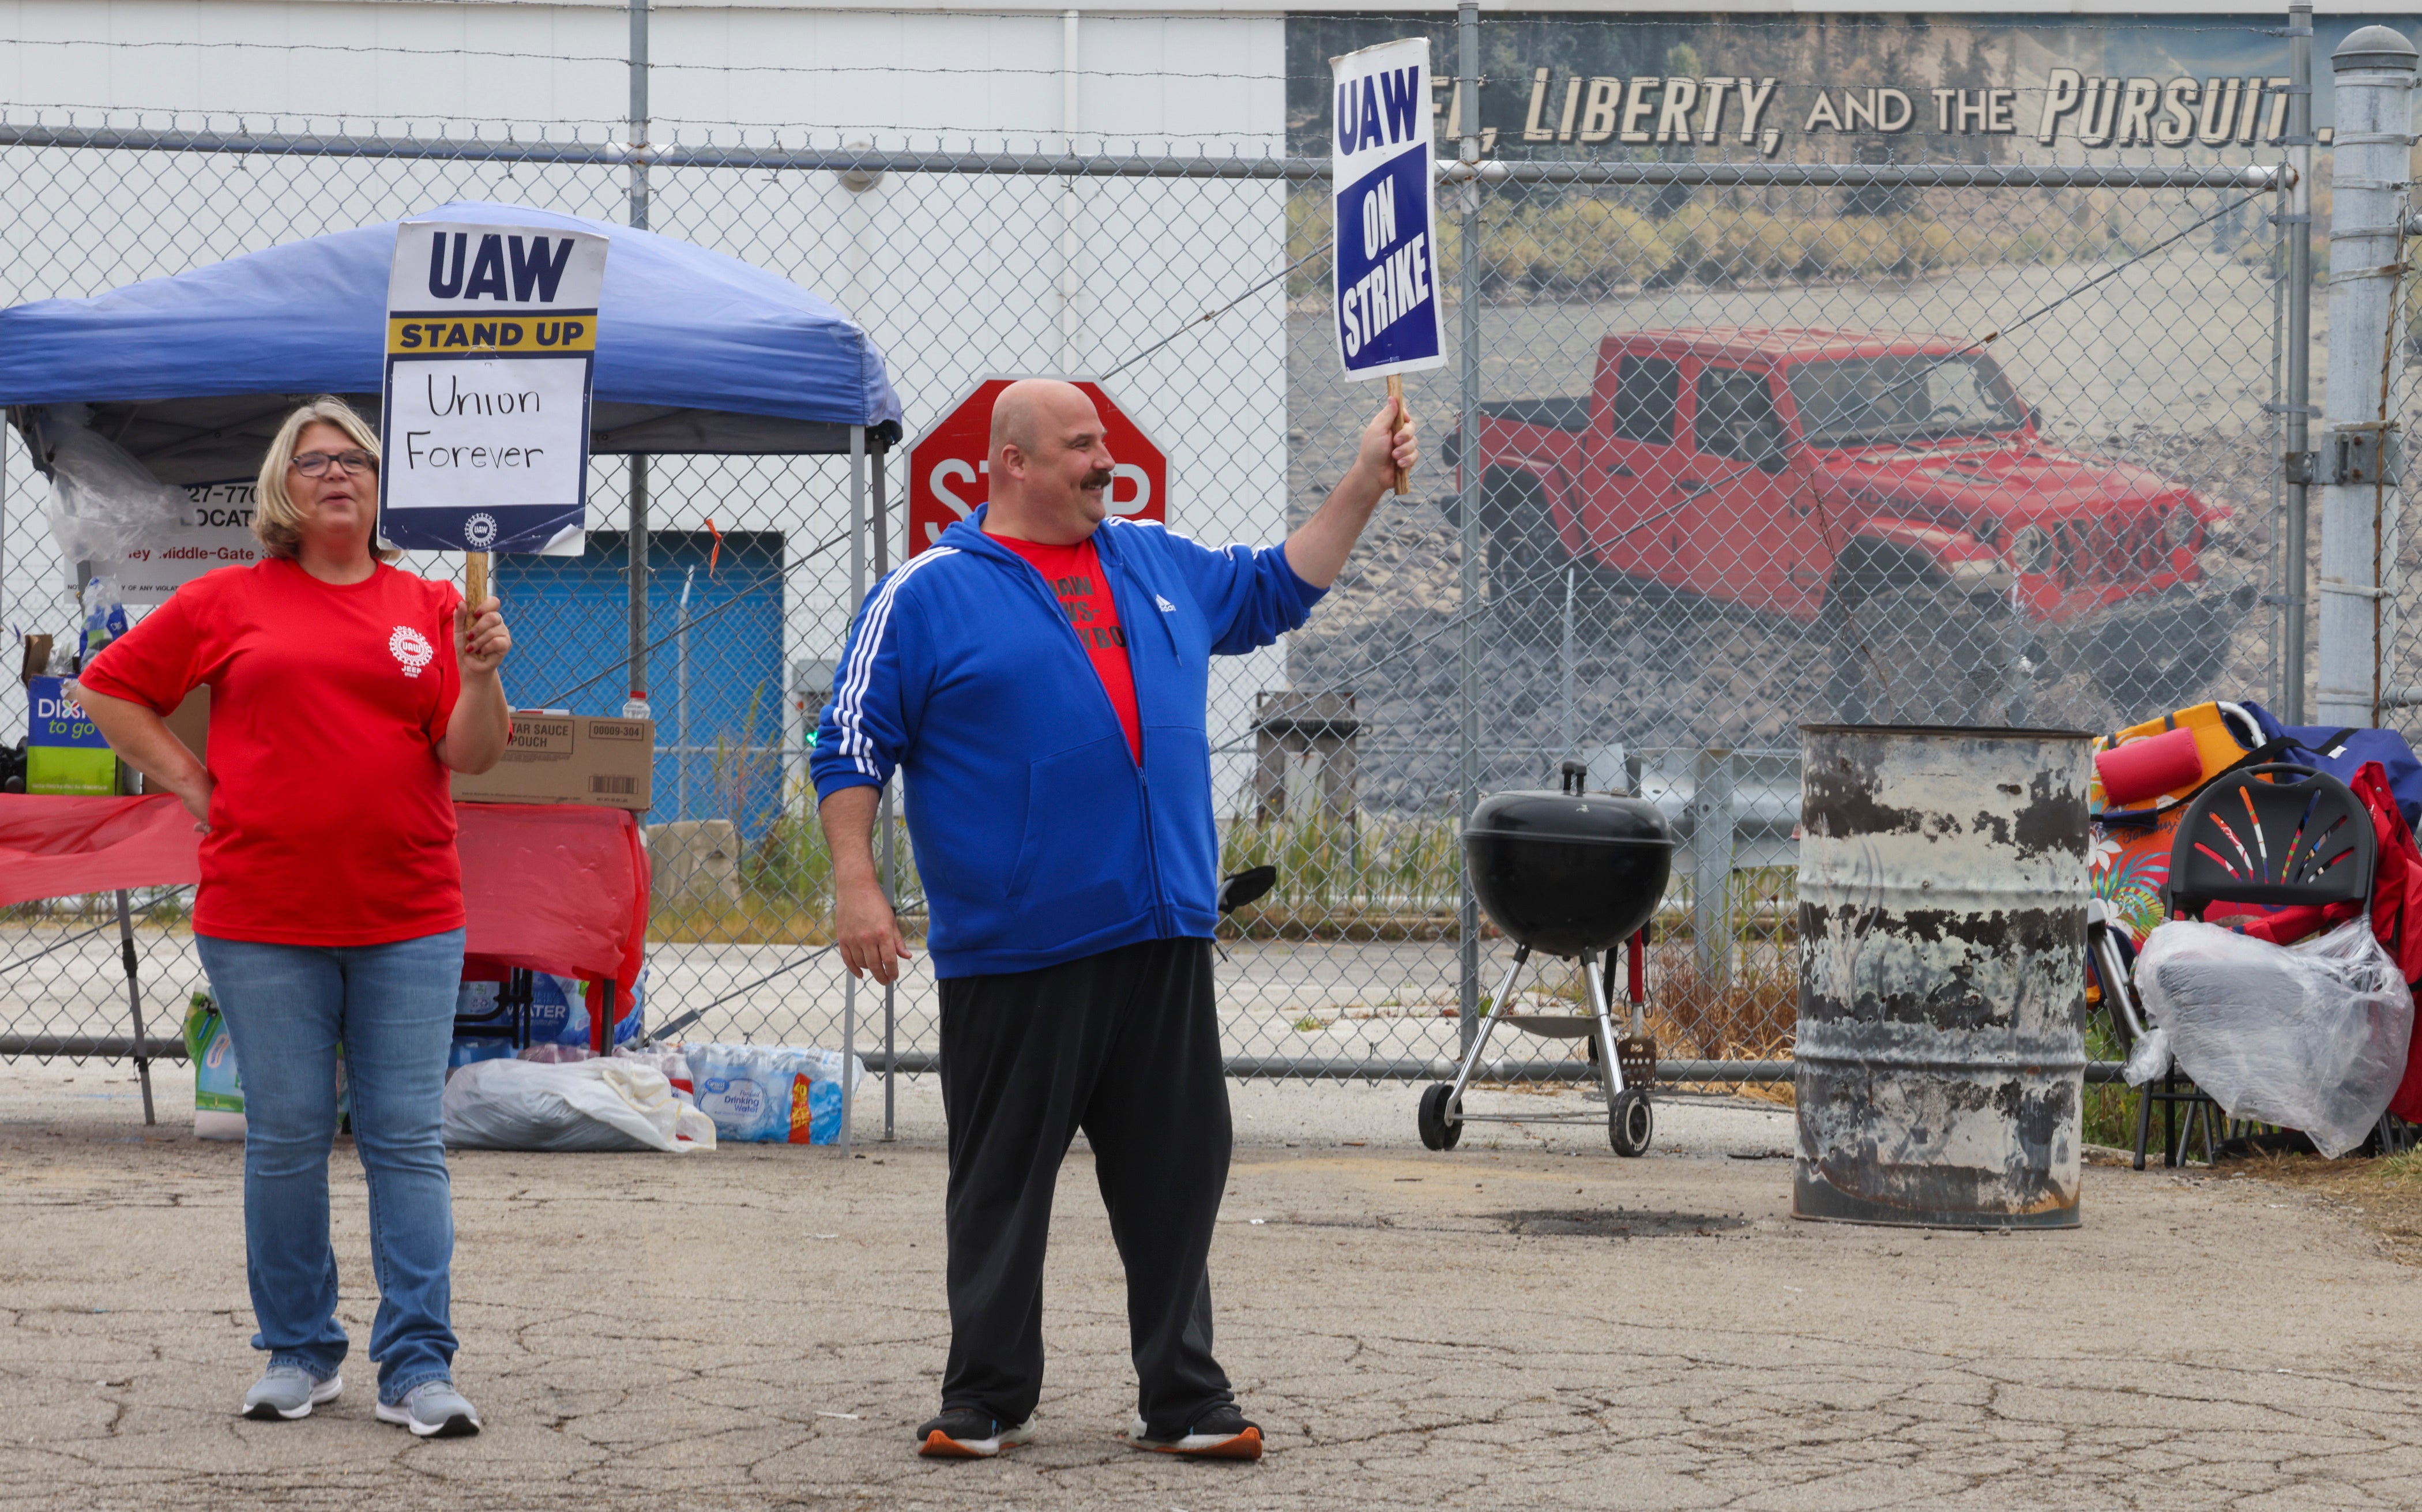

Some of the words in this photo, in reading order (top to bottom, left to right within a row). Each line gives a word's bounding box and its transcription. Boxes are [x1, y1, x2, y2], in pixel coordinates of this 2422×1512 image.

[1338, 65, 1419, 156] UAW
[1524, 67, 1779, 154] LIBERTY,
[1804, 88, 1912, 131] AND
[1932, 89, 2013, 131] THE
[1363, 174, 1397, 260] ON
[429, 231, 575, 303] UAW
[1342, 232, 1429, 358] STRIKE
[400, 322, 524, 348] STAND
[536, 321, 584, 346] UP
[427, 374, 540, 416] Union
[407, 431, 544, 469] Forever
[924, 458, 1151, 546] SP
[474, 525, 488, 533] UAW
[393, 626, 416, 634] LOCAL
[402, 641, 422, 653] UAW
[401, 665, 422, 674] JEEP
[48, 720, 67, 734] to
[71, 722, 95, 739] go
[534, 724, 569, 736] SAUCE
[593, 725, 640, 736] 00009-304
[511, 736, 547, 747] POUCH
[724, 1096, 759, 1107] Drinking
[734, 1104, 758, 1113] Water
